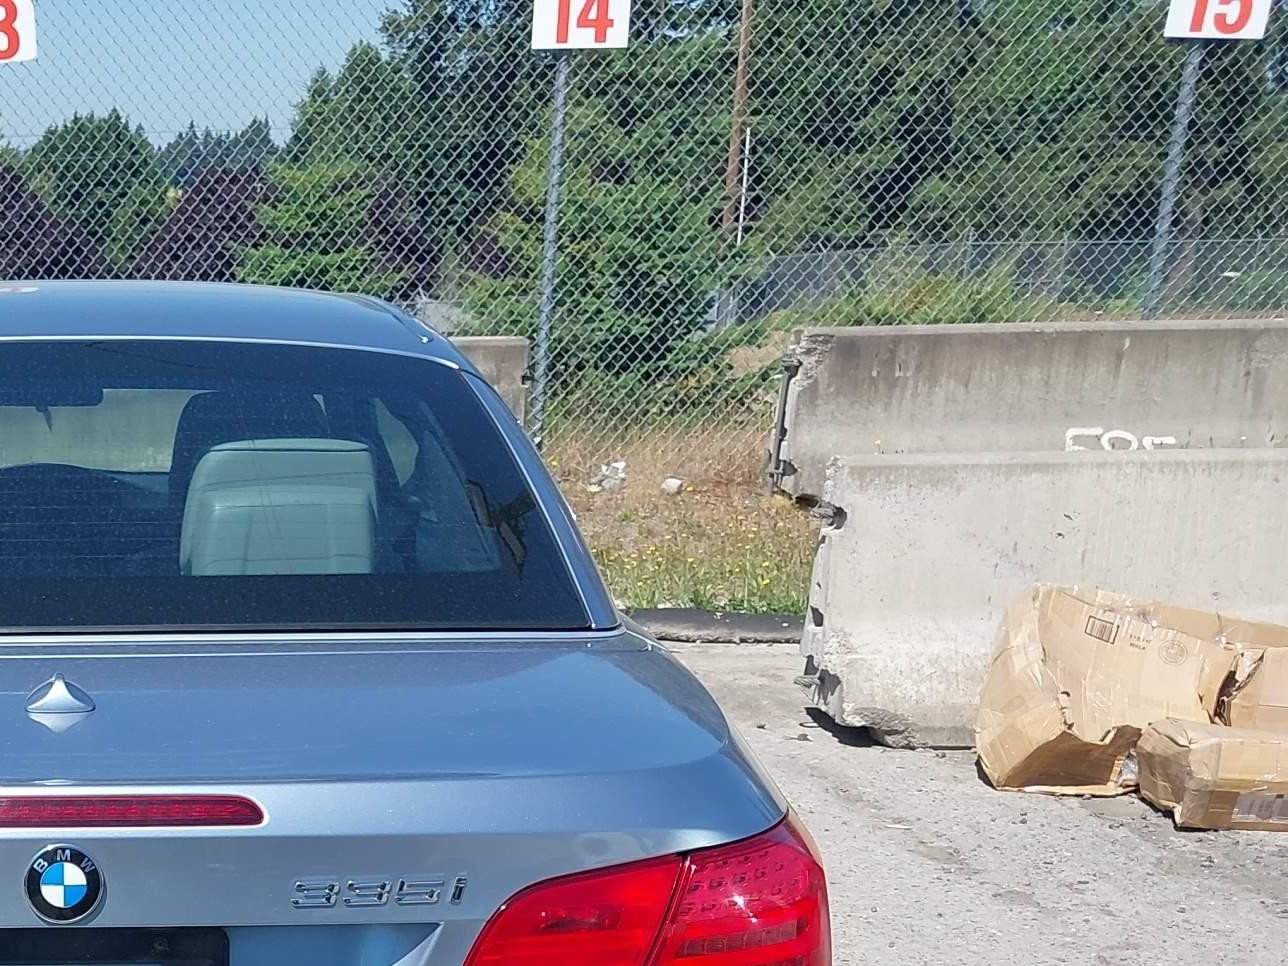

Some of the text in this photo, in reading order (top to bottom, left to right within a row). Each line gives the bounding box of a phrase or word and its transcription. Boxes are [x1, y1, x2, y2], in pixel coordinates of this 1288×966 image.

[556, 0, 614, 43] 14
[1189, 0, 1253, 34] 15
[33, 849, 95, 873] BMW
[290, 874, 468, 908] 335i
